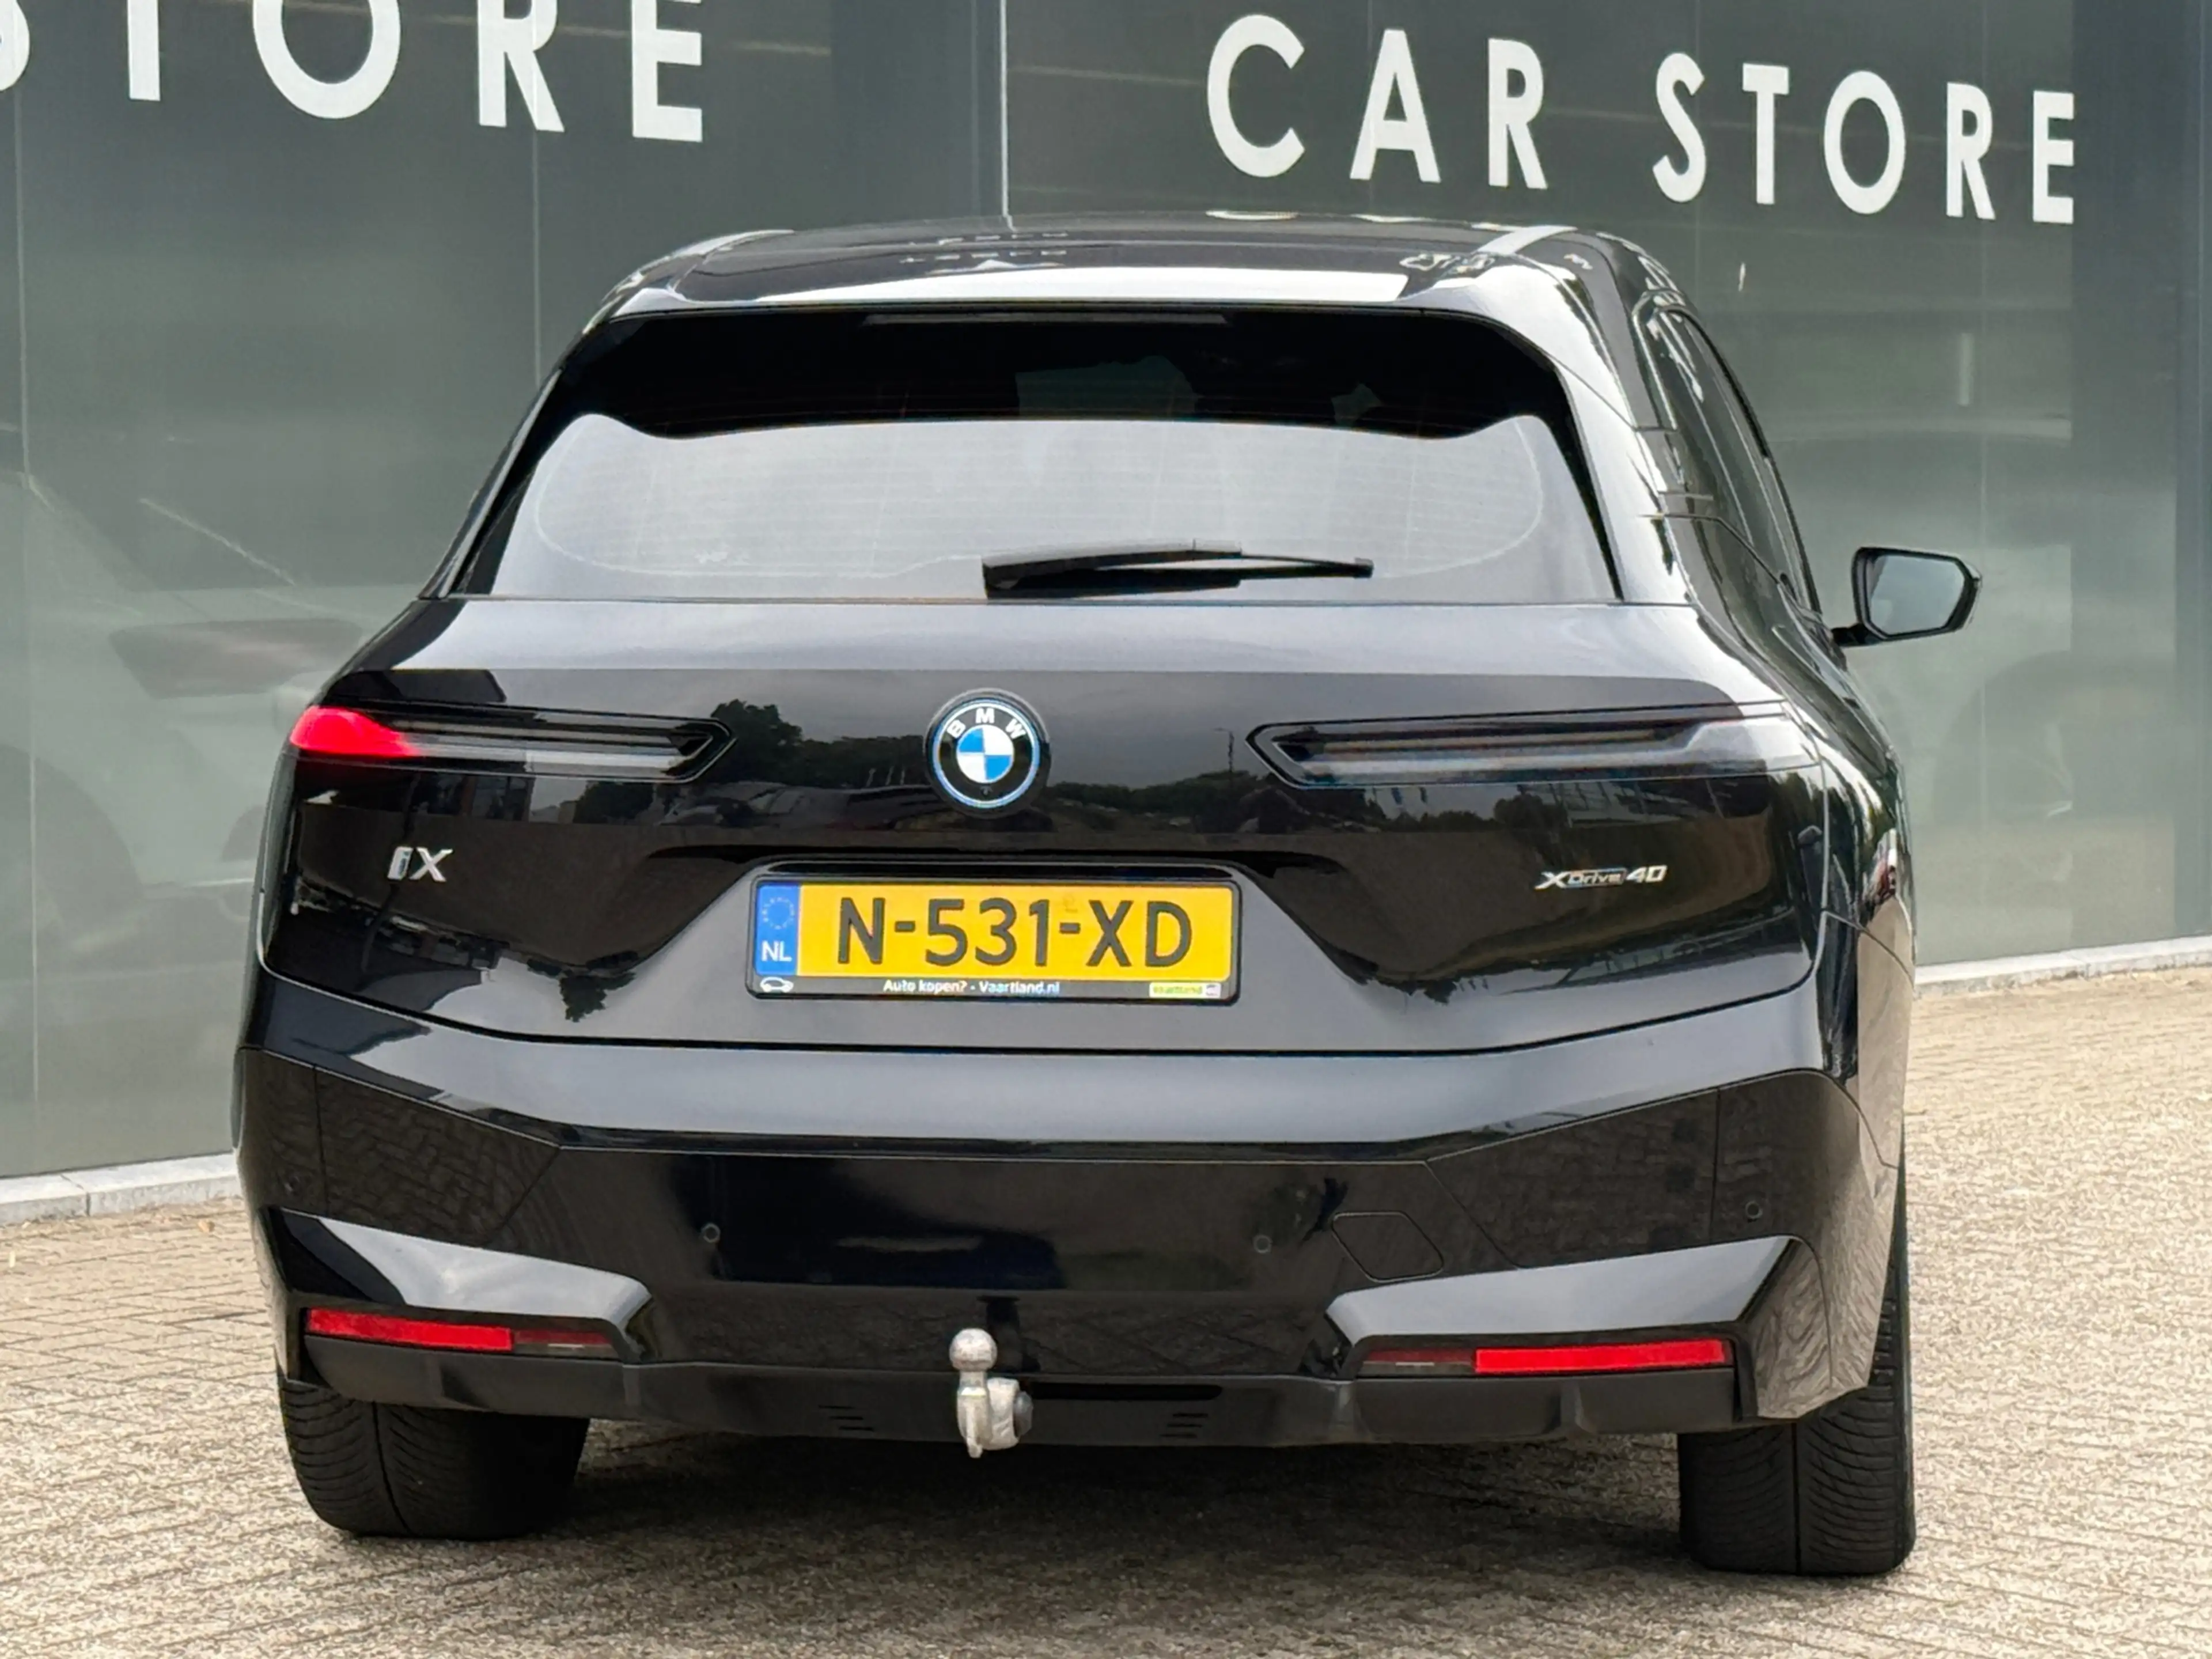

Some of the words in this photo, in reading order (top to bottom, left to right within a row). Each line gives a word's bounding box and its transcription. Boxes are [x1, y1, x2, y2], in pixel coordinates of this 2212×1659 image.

[0, 0, 703, 142] ORE
[1207, 14, 1548, 189] CAR
[1652, 52, 2075, 224] STORE
[946, 707, 1027, 738] BMW
[761, 940, 793, 962] NL
[837, 897, 1192, 968] N-531-XD
[882, 980, 916, 992] Auto
[919, 980, 968, 995] kopen?
[979, 981, 1060, 994] Vaartland.nl
